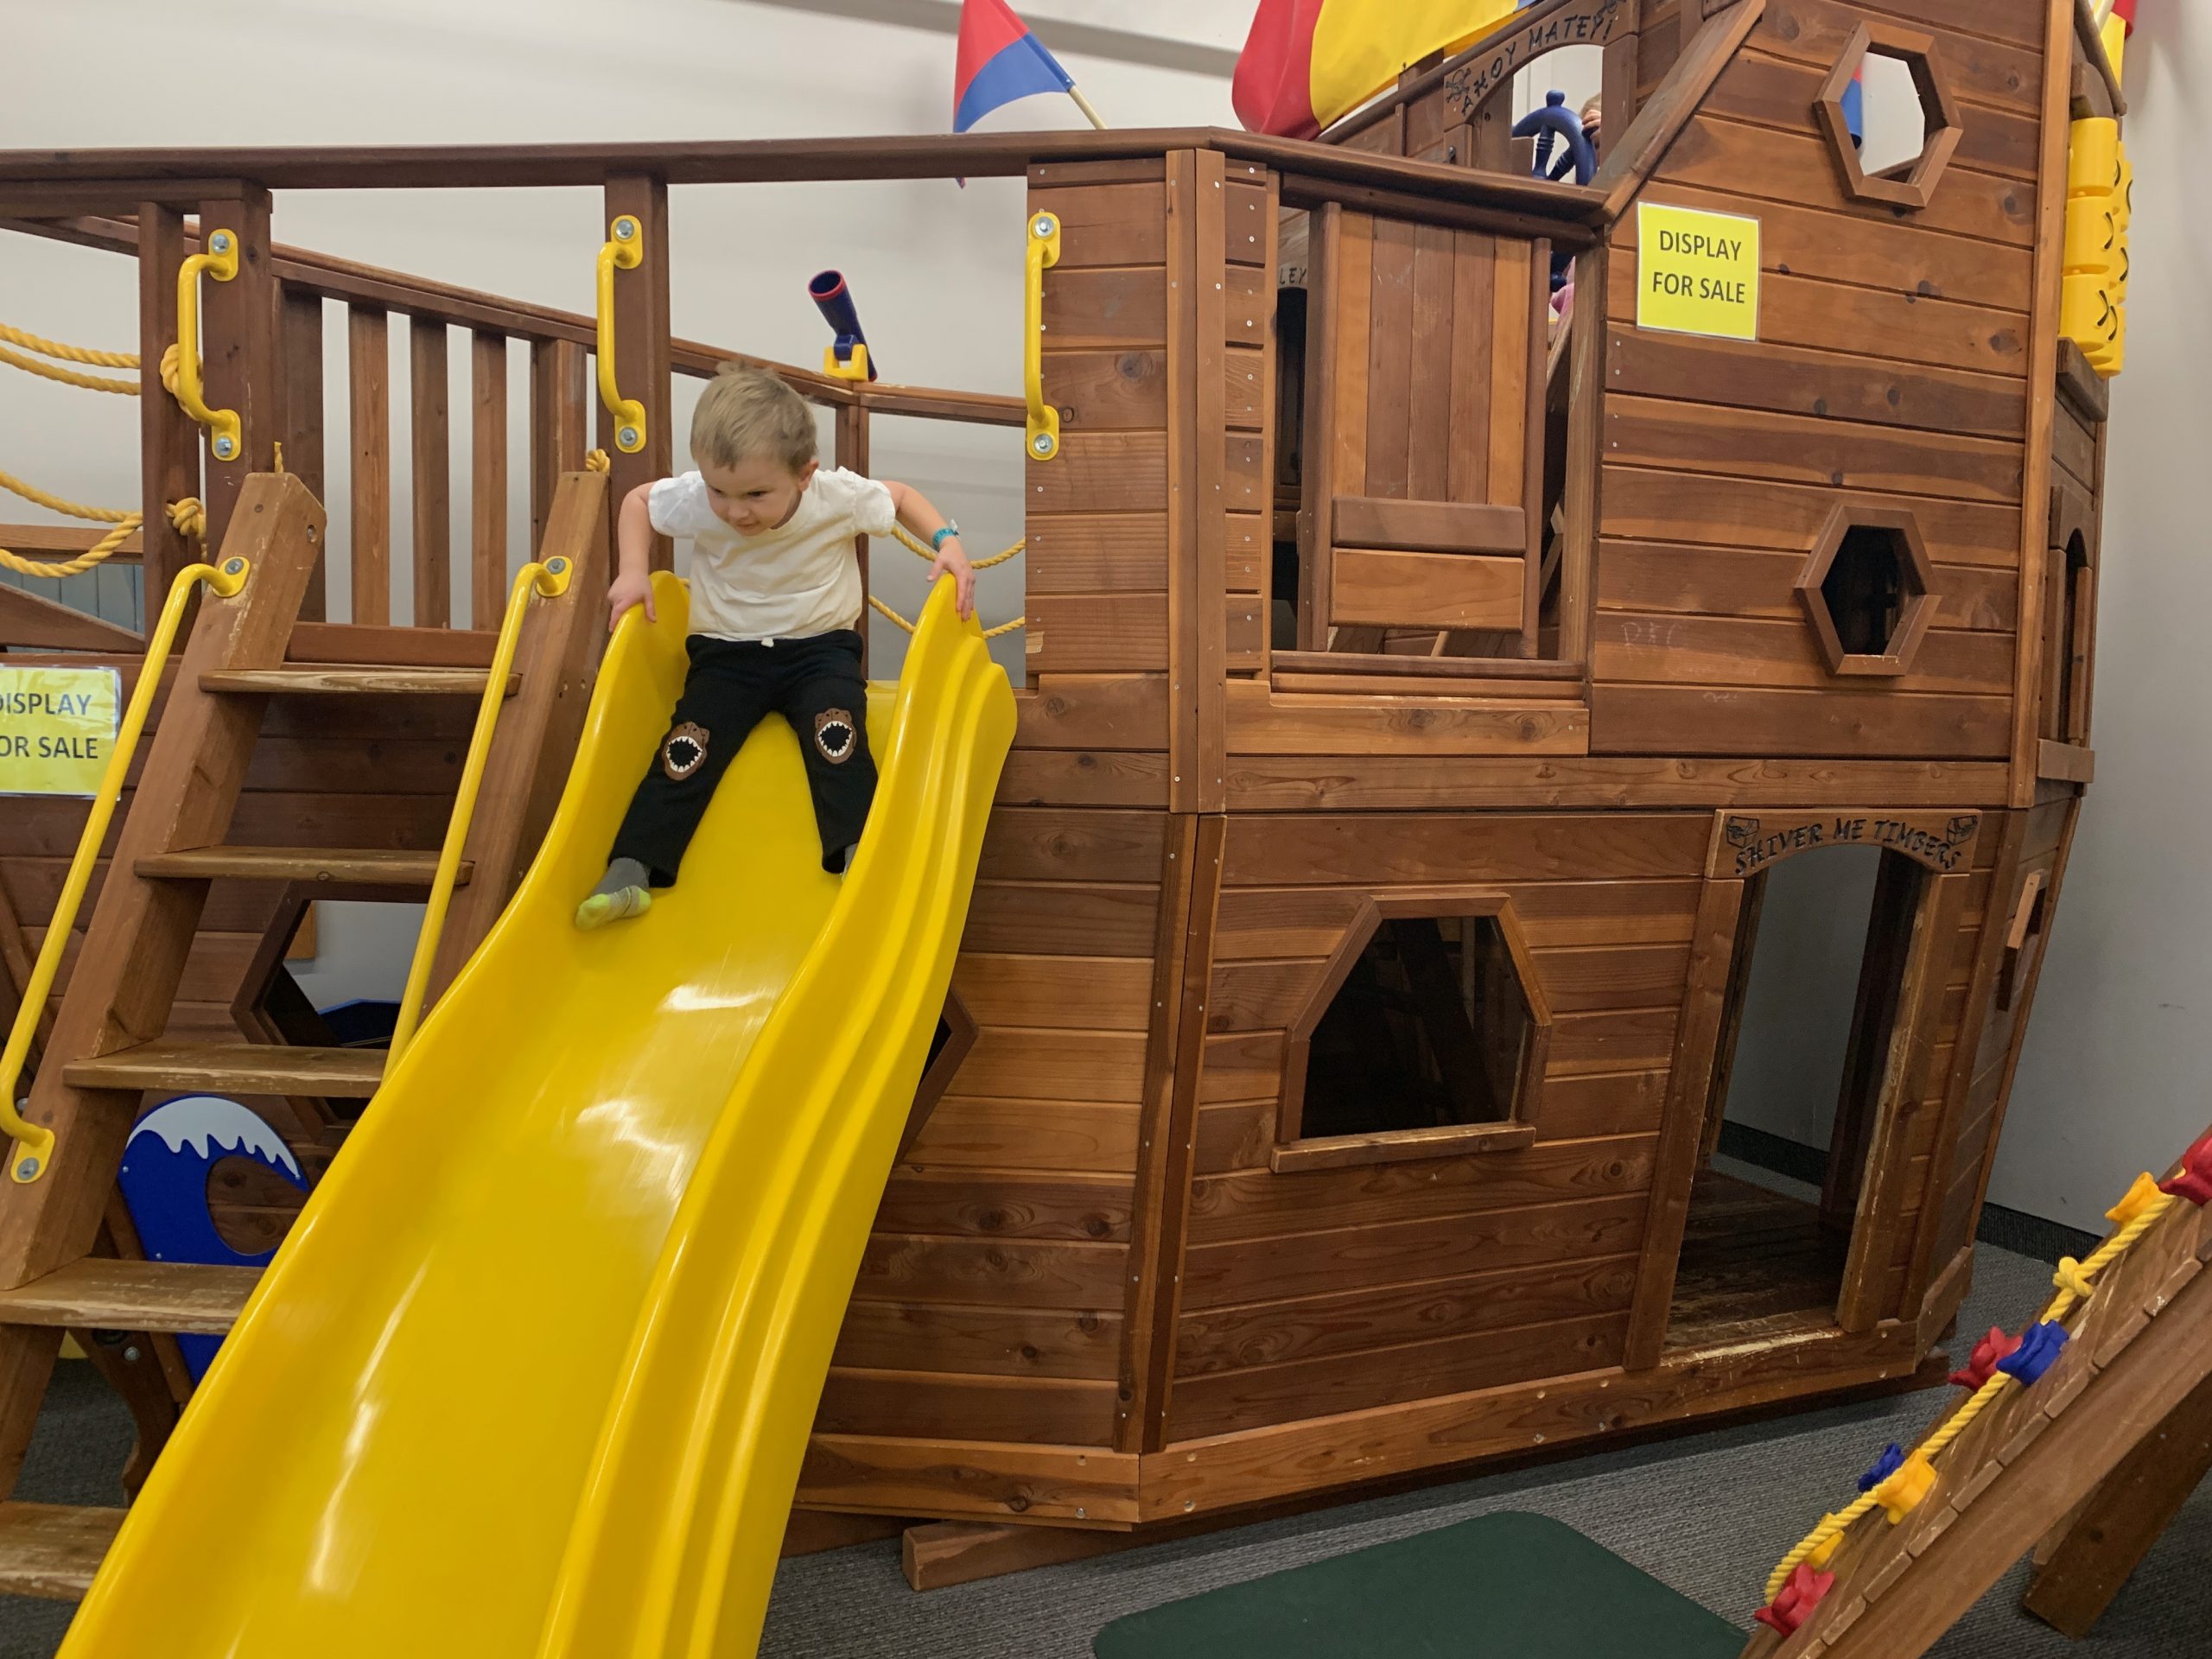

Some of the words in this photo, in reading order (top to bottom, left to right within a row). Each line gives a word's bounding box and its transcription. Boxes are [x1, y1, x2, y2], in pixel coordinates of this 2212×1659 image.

[1462, 42, 1516, 116] AHOY
[1659, 229, 1742, 261] DISPLAY
[1279, 266, 1307, 285] LEY
[1652, 271, 1694, 297] FOR
[1699, 277, 1746, 304] SALE
[0, 692, 92, 715] ISPLAY
[0, 734, 30, 758] OR
[38, 736, 99, 760] SALE
[1735, 823, 1823, 875] SHIVER
[1833, 817, 1867, 841] ME
[1874, 819, 1962, 871] TIMBERS
